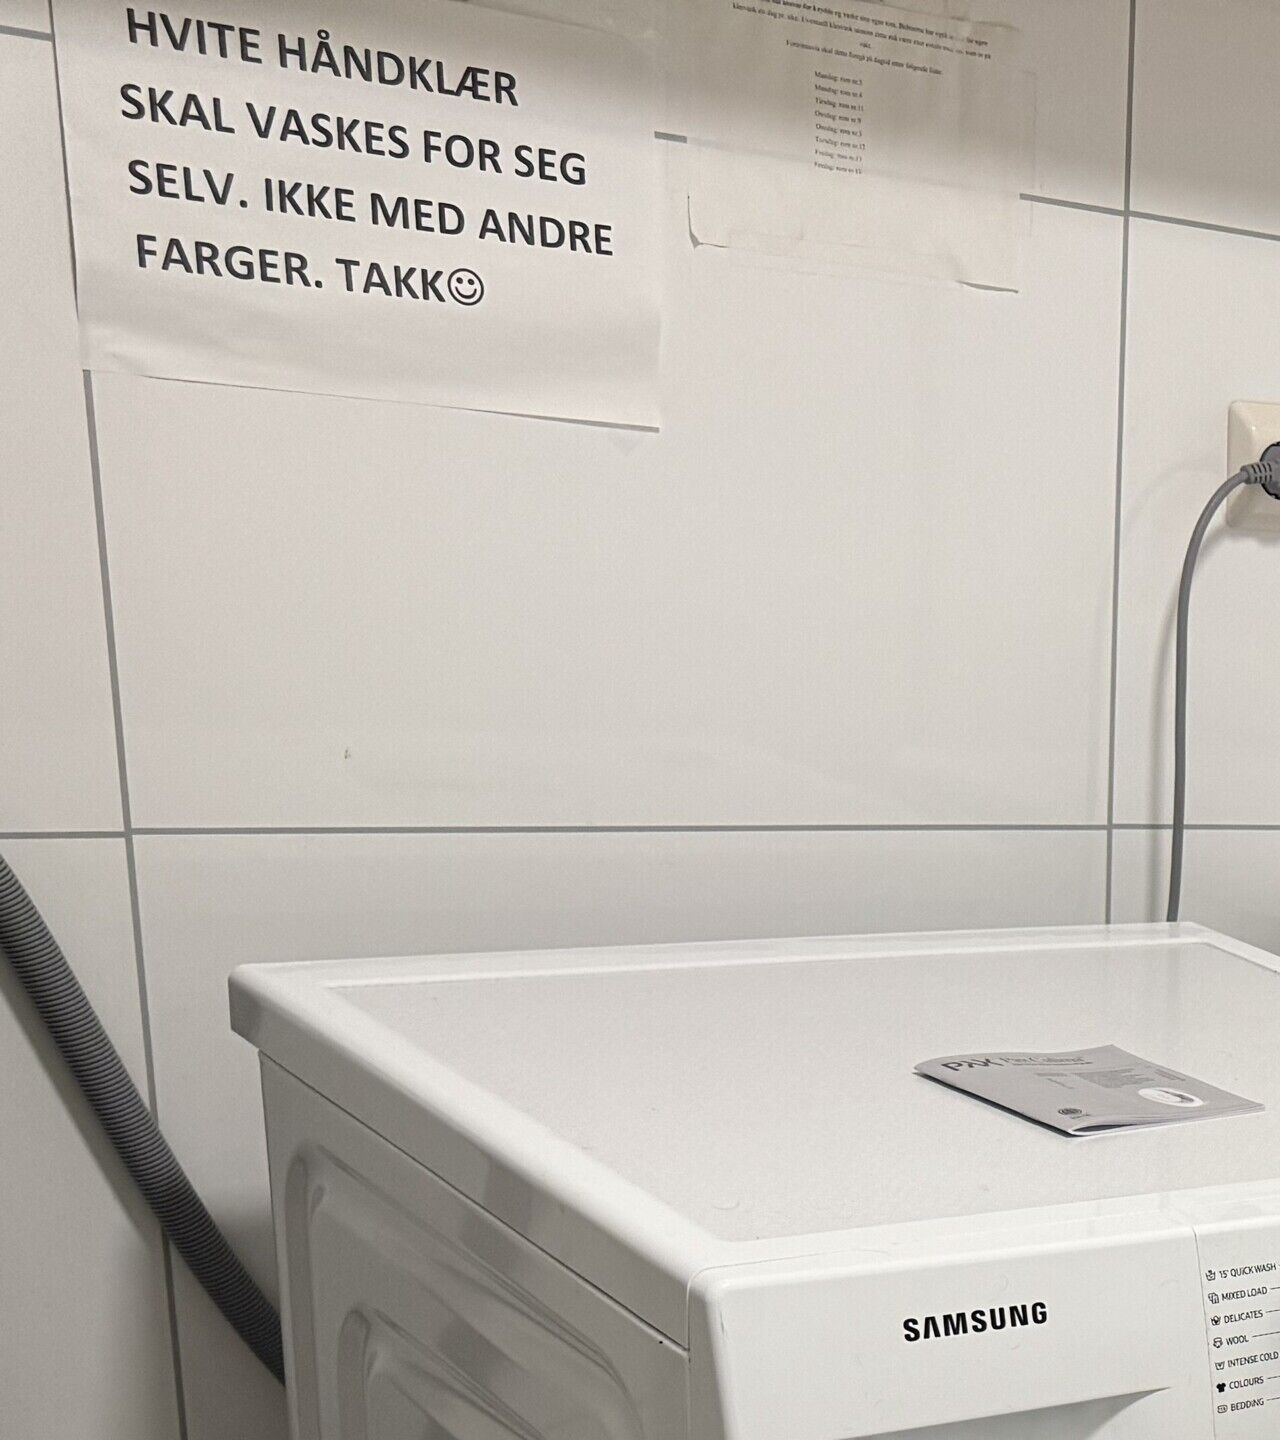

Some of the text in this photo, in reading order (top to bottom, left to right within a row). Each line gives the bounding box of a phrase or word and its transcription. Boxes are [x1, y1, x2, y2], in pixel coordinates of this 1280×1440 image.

[126, 7, 519, 107] HVITE HÅNDKLÆR
[120, 83, 587, 186] SKAL VASKES FOR SEG
[128, 159, 614, 257] SELV. IKKE MED ANDRE
[136, 233, 324, 289] FARGER.
[1230, 1266, 1254, 1278] QUICK
[1254, 1263, 1277, 1274] WASH
[1222, 1286, 1268, 1302] MIXED LOAD
[902, 1301, 1048, 1343] SAMSUNG
[1224, 1309, 1264, 1325] DELICATES
[1226, 1334, 1249, 1347] WOOL
[1227, 1350, 1279, 1369] INTENSE COLD
[1229, 1376, 1264, 1390] COLOURS
[1231, 1398, 1265, 1412] BEDDING
